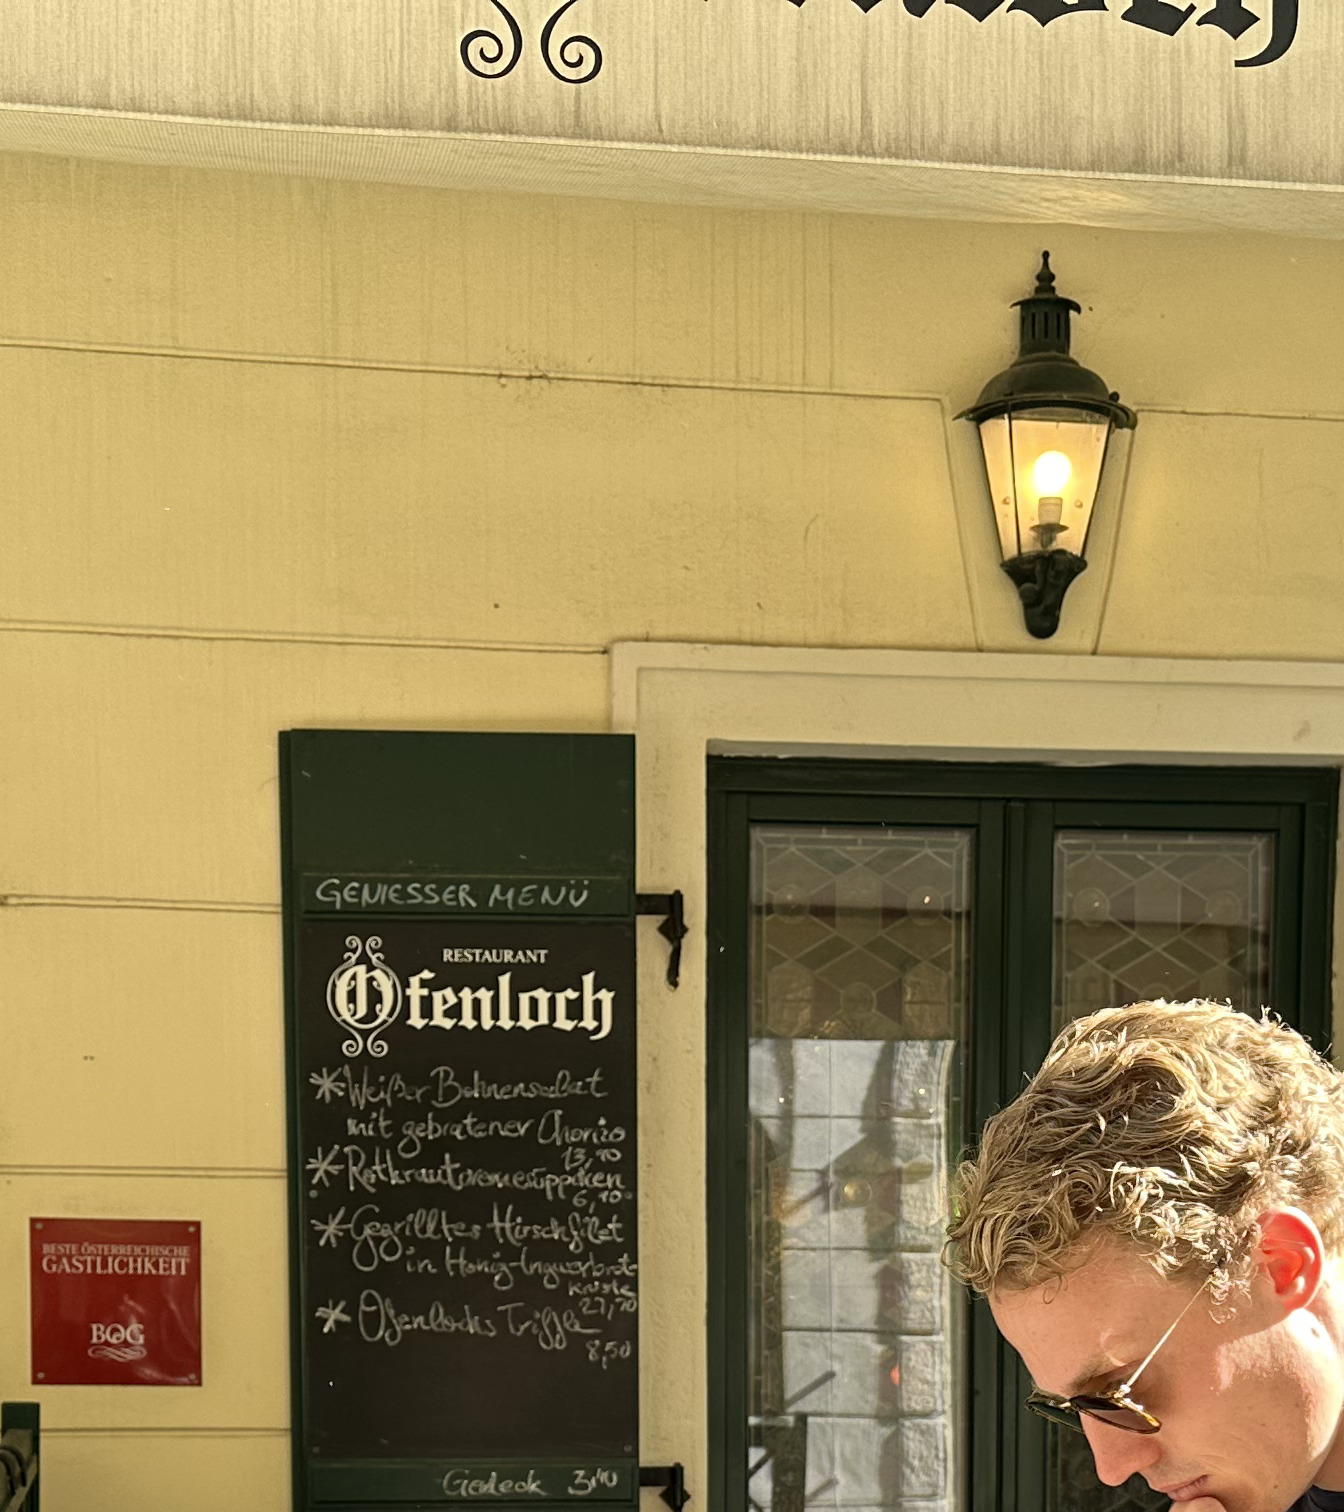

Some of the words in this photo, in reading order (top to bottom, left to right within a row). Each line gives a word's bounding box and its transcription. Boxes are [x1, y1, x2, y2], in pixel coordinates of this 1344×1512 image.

[316, 877, 477, 910] GENIESSER
[489, 880, 589, 908] MENÜ
[442, 948, 549, 964] RESTAURANT
[326, 958, 616, 1042] Ofenloch
[430, 1066, 608, 1108] Bohnensalat
[347, 1107, 393, 1138] mit
[397, 1111, 535, 1158] gebratener
[537, 1109, 625, 1146] Chorizo
[42, 1243, 79, 1255] BESTE
[406, 1246, 437, 1273] in
[42, 1255, 190, 1276] GASTLICHKEIT
